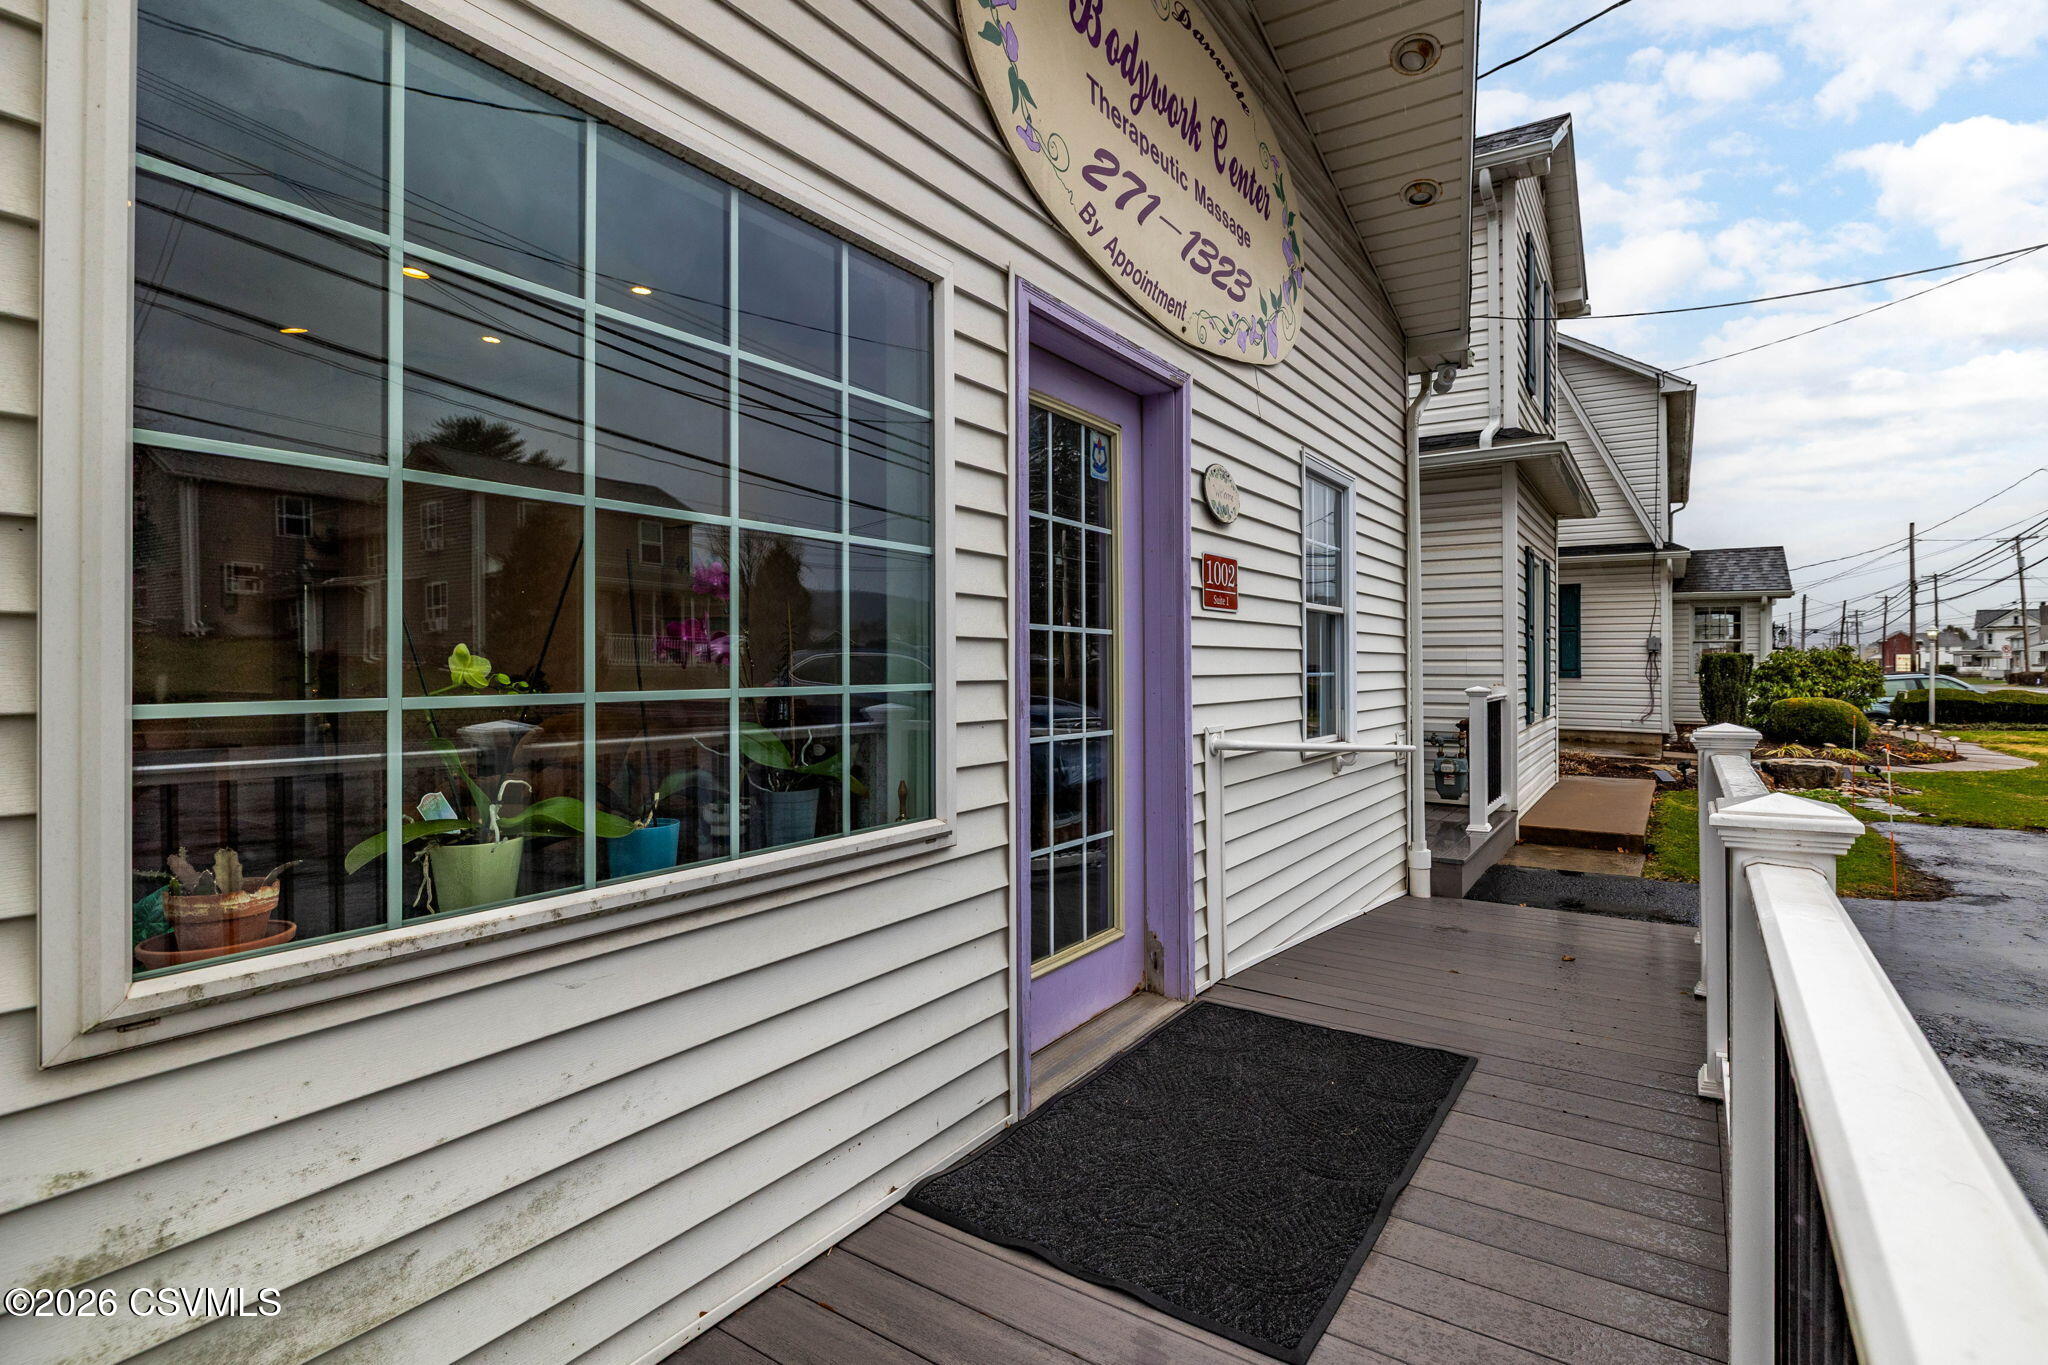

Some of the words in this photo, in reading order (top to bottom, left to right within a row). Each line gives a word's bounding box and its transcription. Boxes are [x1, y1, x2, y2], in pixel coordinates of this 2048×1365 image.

[1069, 0, 1201, 152] Bodywork
[1211, 115, 1271, 221] Center
[1172, 1, 1249, 117] Danville
[1086, 72, 1188, 191] Therapeutic
[1194, 178, 1251, 248] Massage
[1078, 201, 1104, 237] By
[1104, 236, 1188, 321] Appointment
[1206, 559, 1235, 587] 1002
[1213, 594, 1226, 606] Suite
